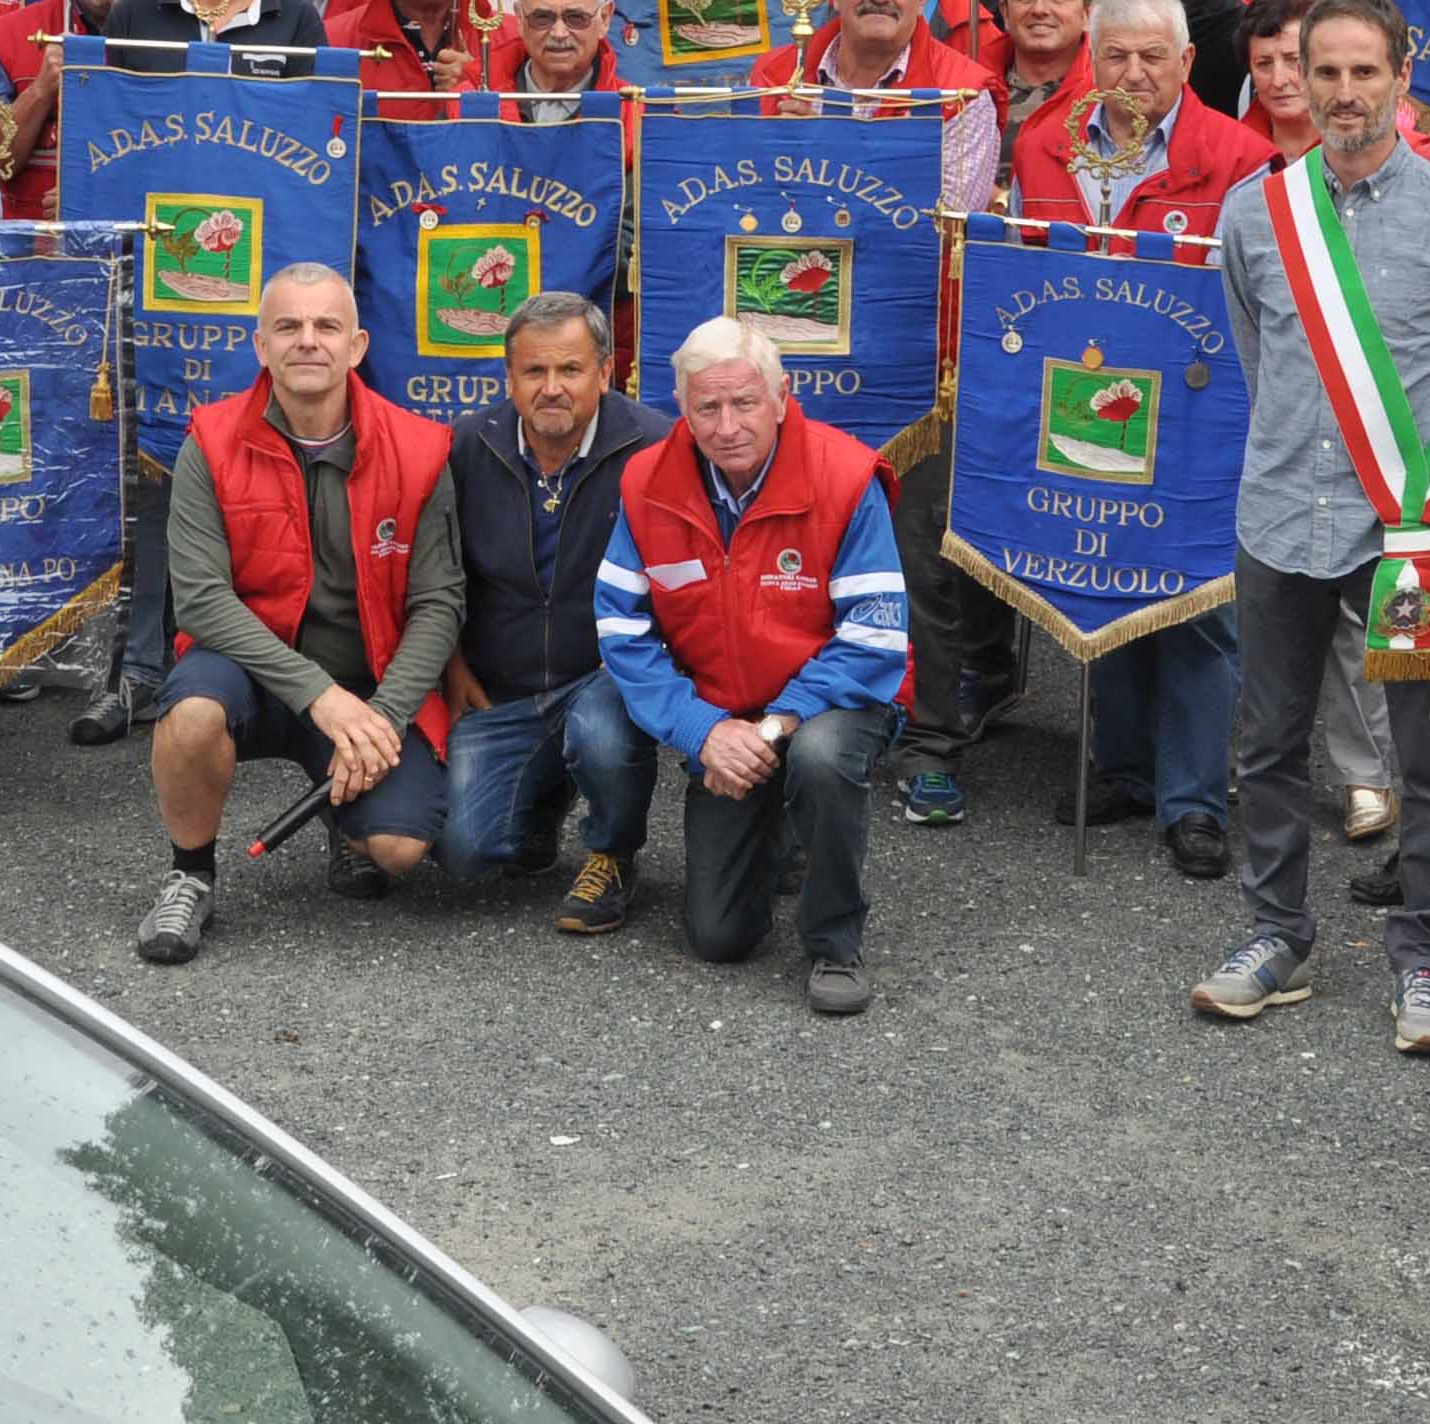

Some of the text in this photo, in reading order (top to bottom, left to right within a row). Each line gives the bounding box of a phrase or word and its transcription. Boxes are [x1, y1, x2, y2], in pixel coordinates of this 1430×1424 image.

[195, 111, 331, 185] SALUZZO
[468, 162, 597, 227] SALUZZO
[774, 156, 919, 230] SALUZZO
[133, 321, 247, 350] GRUPP
[1095, 278, 1224, 355] SALUZZO
[184, 359, 211, 382] DI
[1027, 486, 1164, 528] GRUPPO
[1074, 528, 1108, 558] DI
[43, 557, 76, 583] PO
[1002, 548, 1184, 596] VERZUOLO
